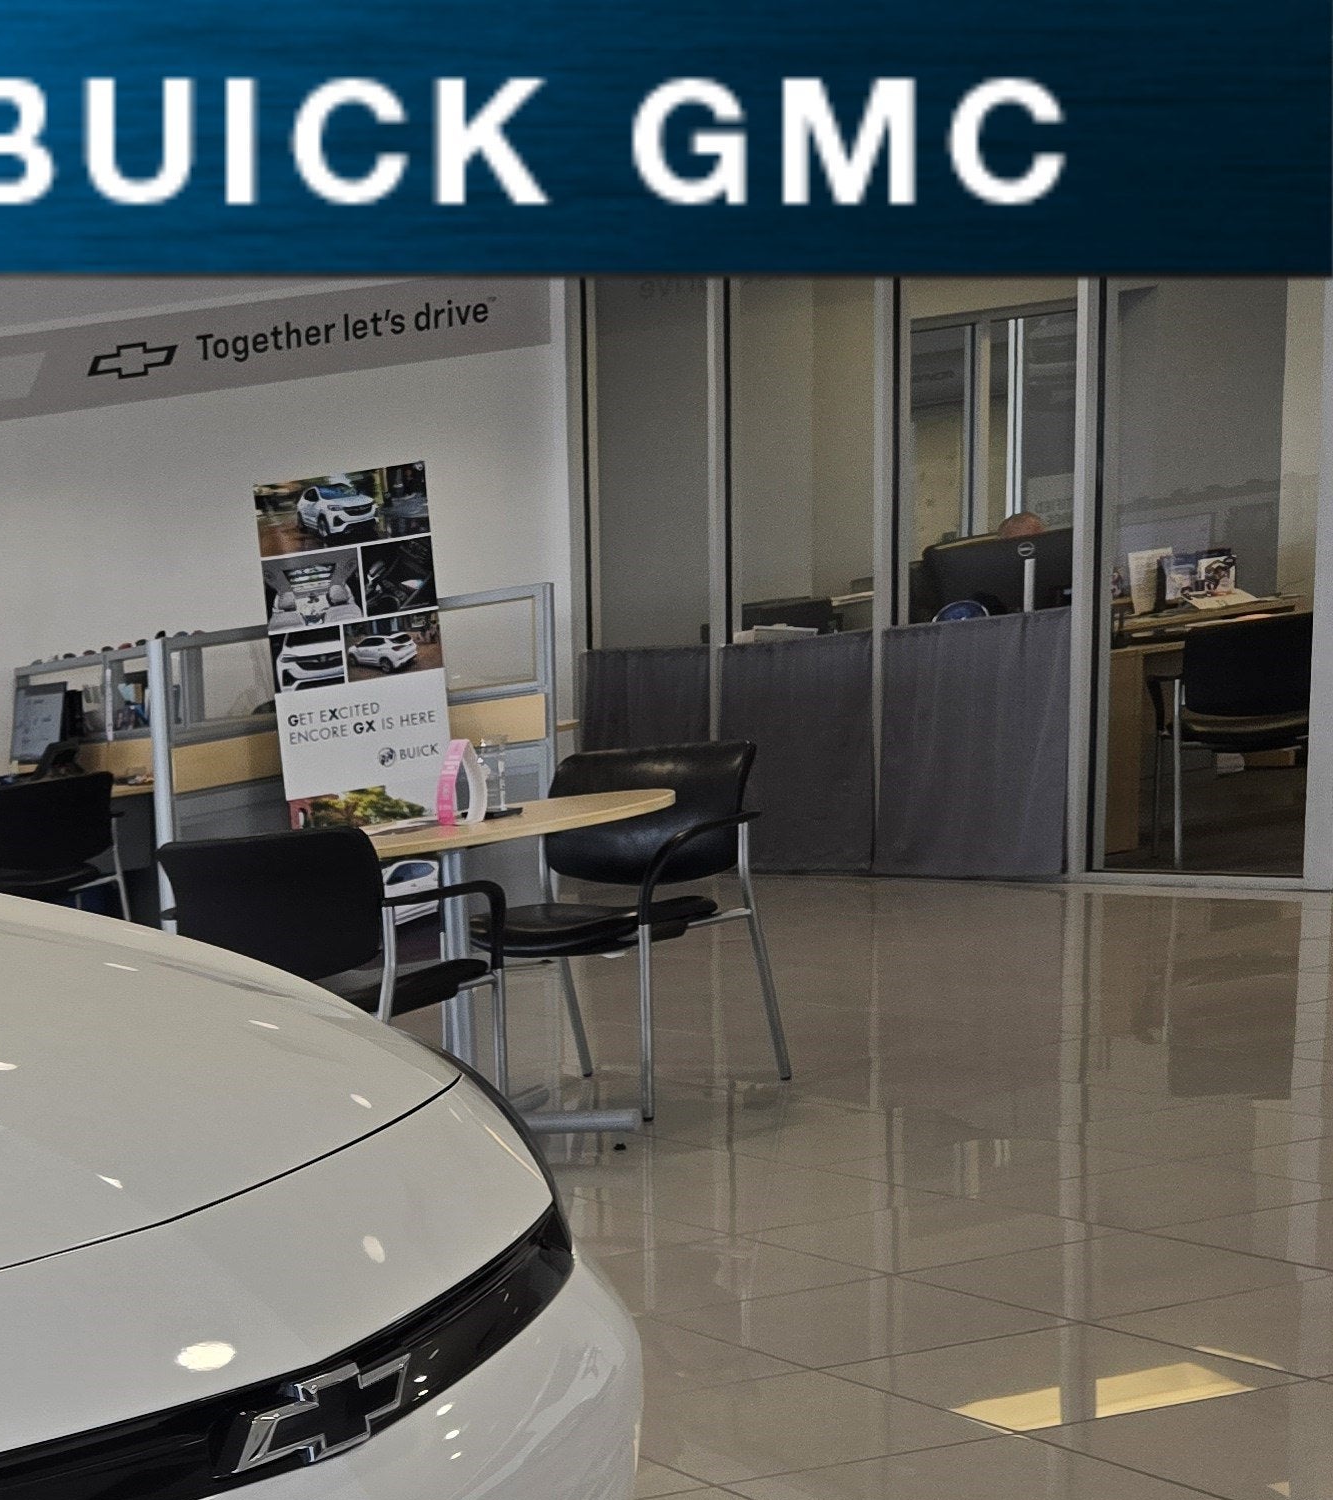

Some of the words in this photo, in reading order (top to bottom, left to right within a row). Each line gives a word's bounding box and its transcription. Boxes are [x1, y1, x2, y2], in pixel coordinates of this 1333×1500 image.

[195, 321, 336, 363] Together
[343, 308, 406, 342] let's
[287, 711, 315, 727] GET
[319, 702, 381, 724] EXCITED
[289, 725, 349, 745] ENCORE
[353, 719, 376, 735] GX
[382, 717, 395, 731] IS
[399, 710, 436, 728] HERE
[399, 743, 440, 760] BUICK
